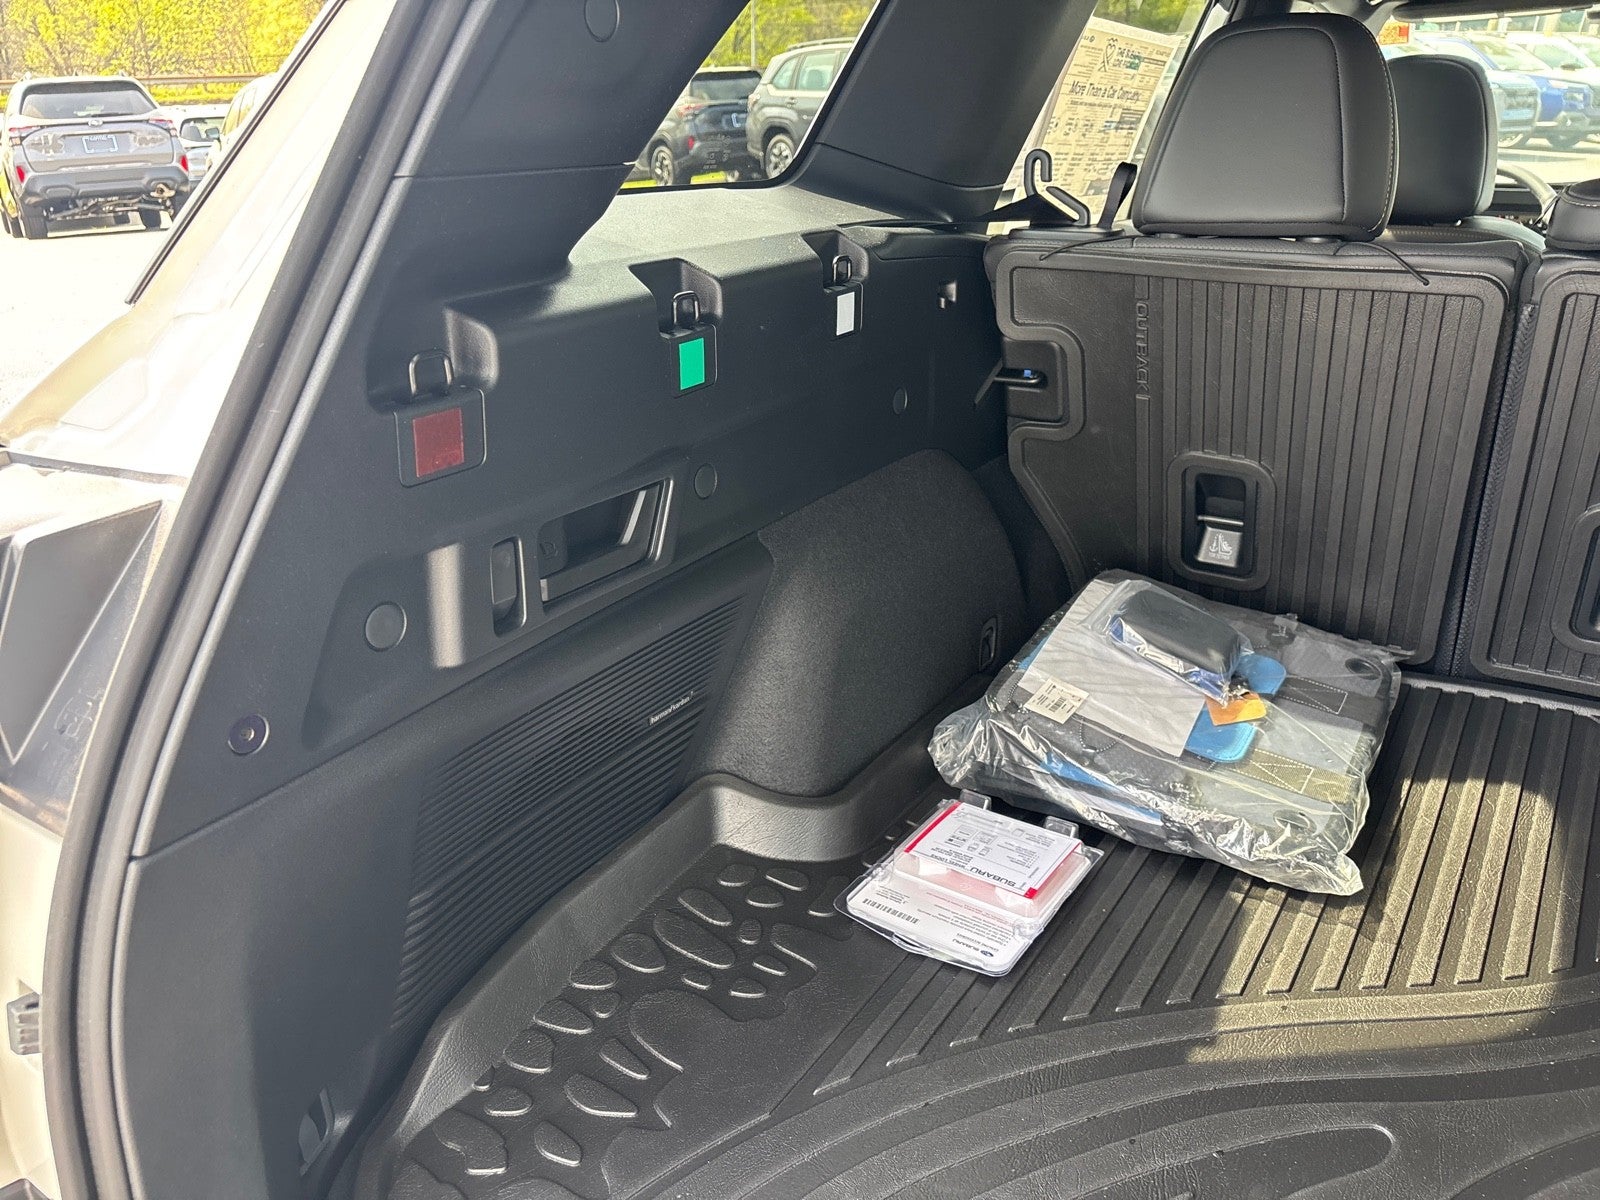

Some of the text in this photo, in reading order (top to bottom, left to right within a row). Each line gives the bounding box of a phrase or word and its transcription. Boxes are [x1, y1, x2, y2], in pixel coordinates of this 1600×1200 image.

[1070, 80, 1086, 96] More
[1087, 83, 1101, 96] Than
[1136, 302, 1149, 392] OUTBACK
[970, 866, 1016, 887] SUBARU
[951, 938, 980, 951] SUBARU
